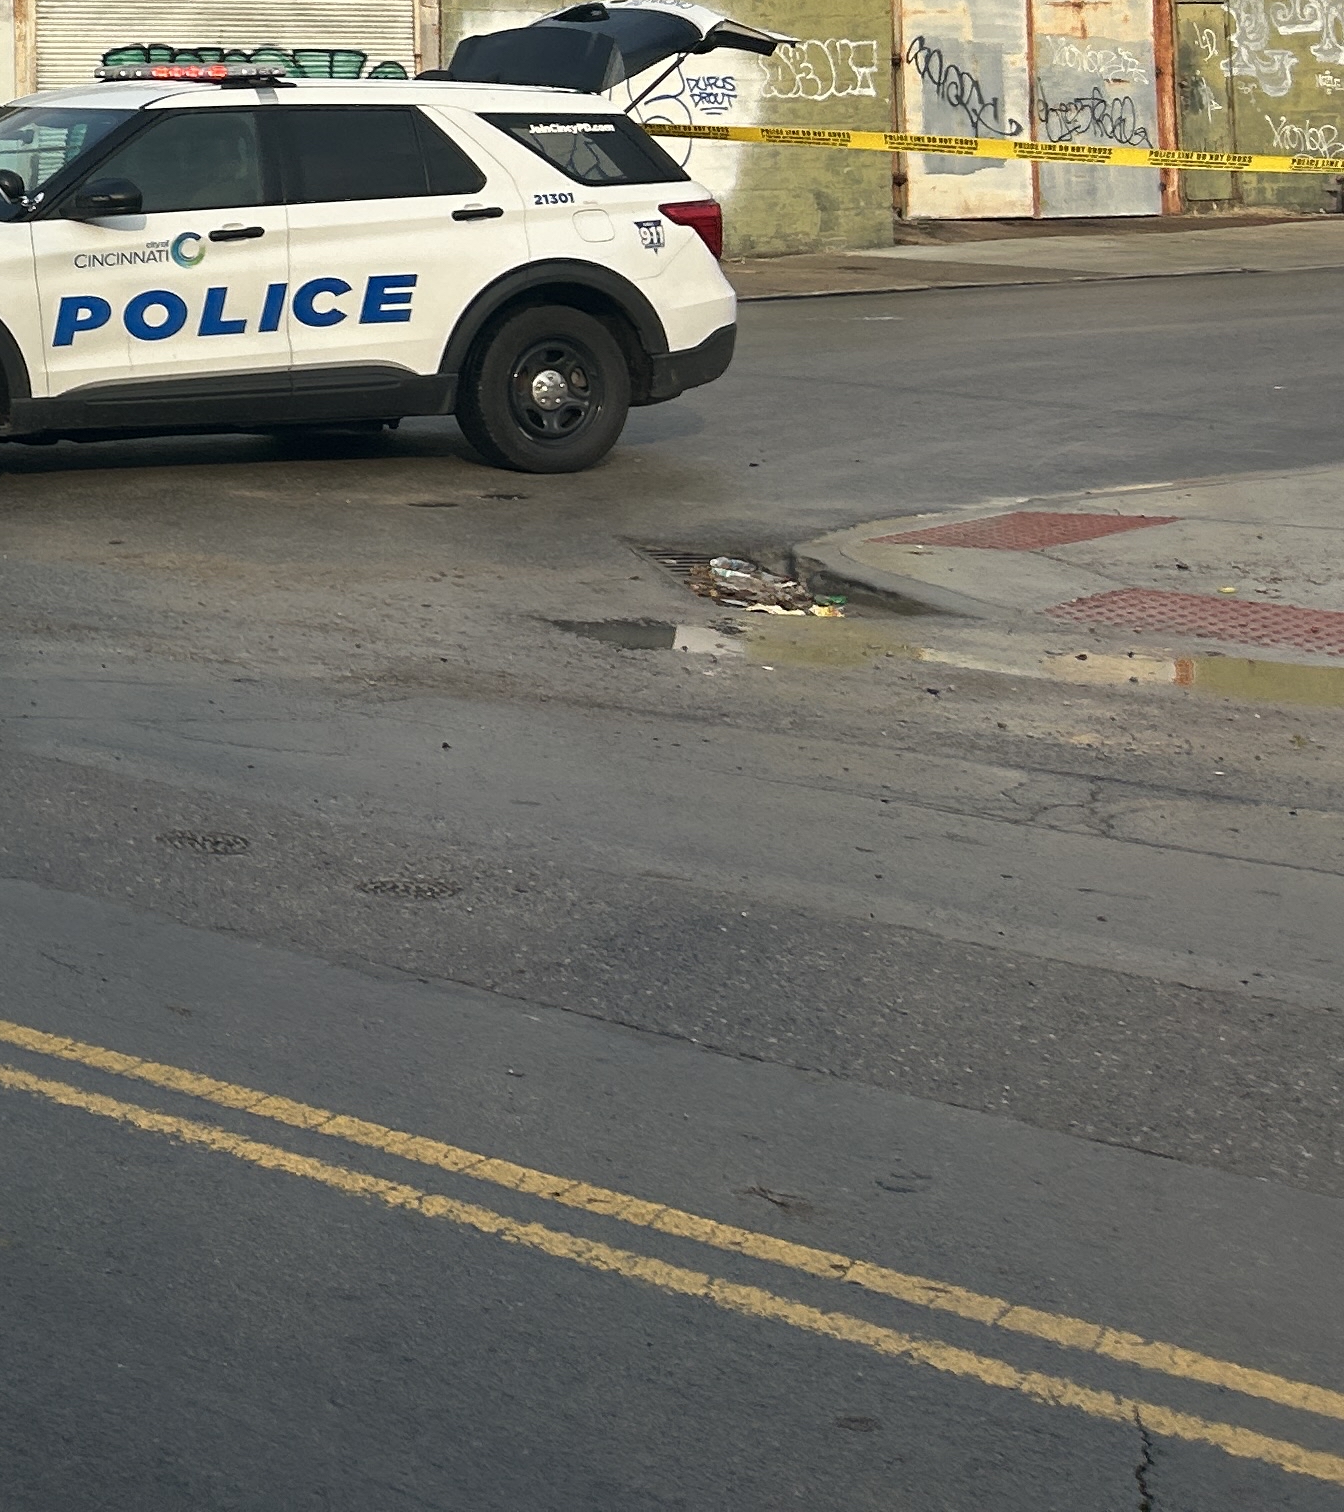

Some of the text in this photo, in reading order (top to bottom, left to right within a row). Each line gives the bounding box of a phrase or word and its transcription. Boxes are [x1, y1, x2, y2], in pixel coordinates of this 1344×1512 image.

[1014, 142, 1038, 150] POLICE
[1088, 147, 1112, 155] CROSS
[1149, 150, 1175, 158] POLICE
[1227, 154, 1252, 163] CROSS
[1292, 159, 1320, 167] POLICE
[534, 192, 575, 205] 21301
[640, 226, 664, 245] 911
[73, 249, 169, 269] CINCINNATI
[52, 273, 418, 347] POLICE
